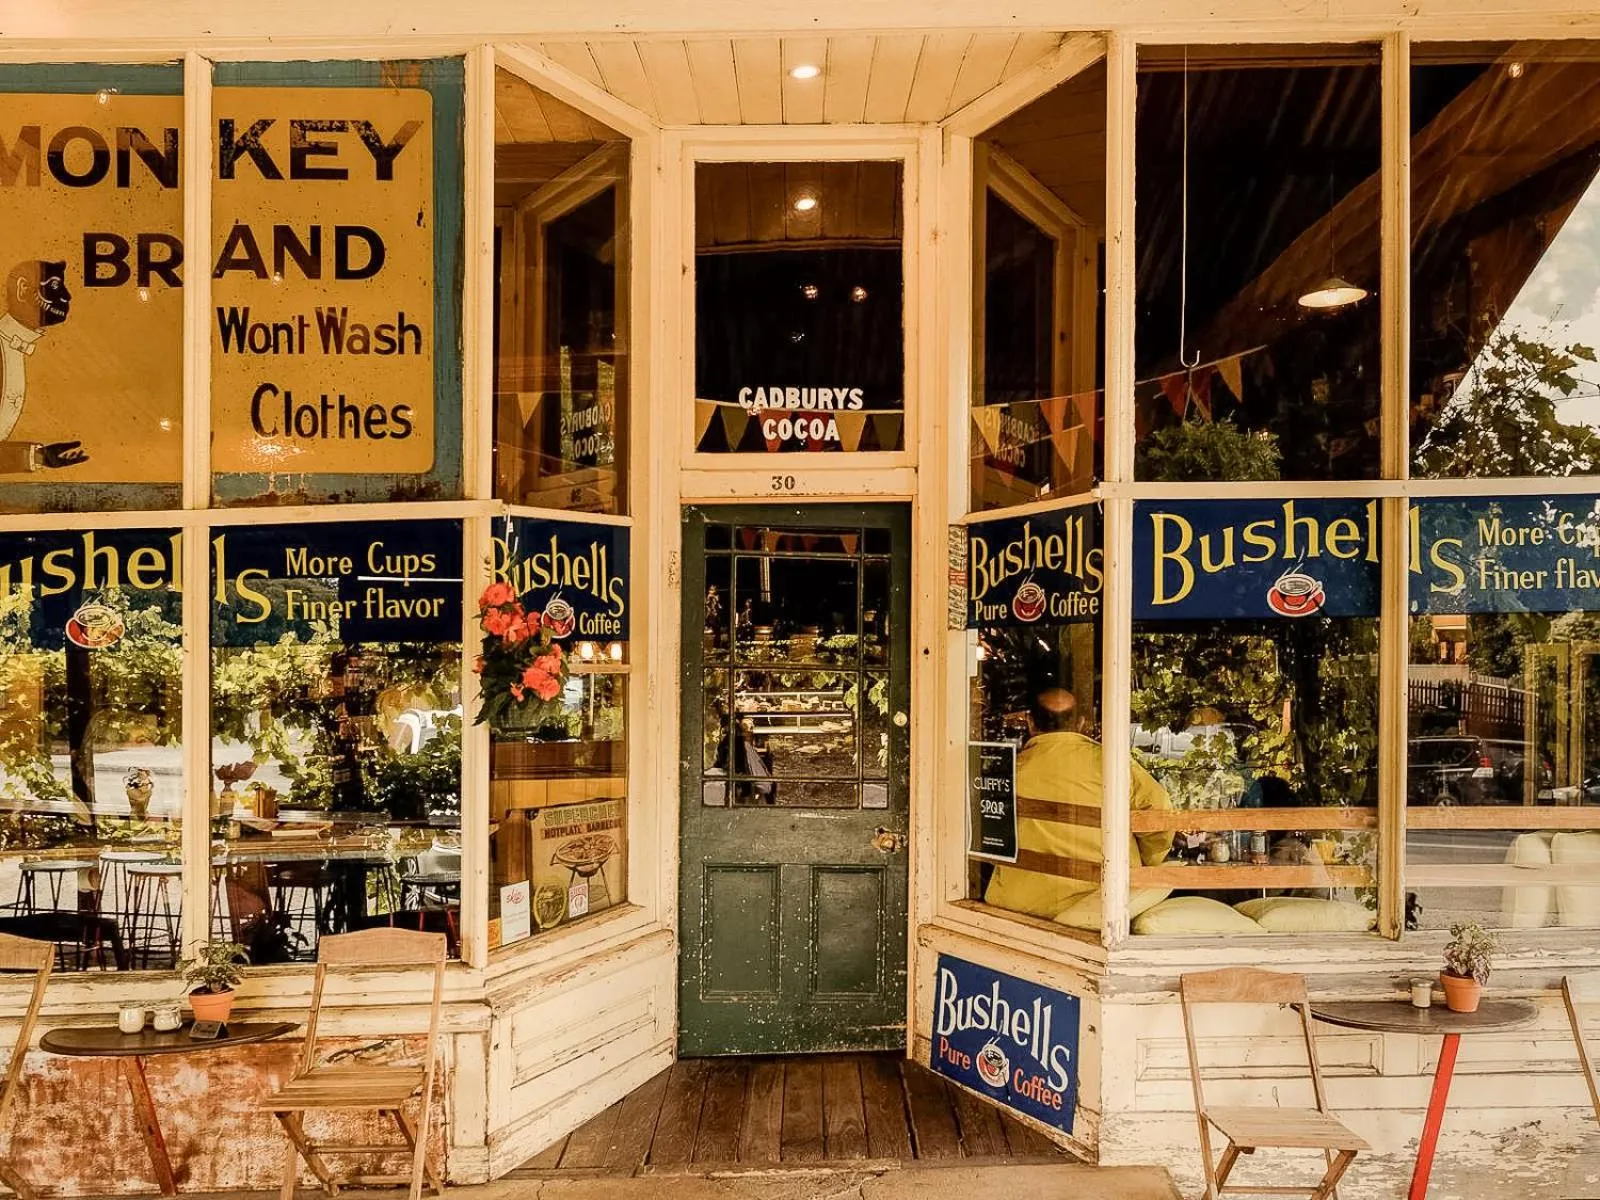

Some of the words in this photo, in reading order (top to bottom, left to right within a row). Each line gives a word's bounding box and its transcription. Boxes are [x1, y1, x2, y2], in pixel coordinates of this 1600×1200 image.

[83, 225, 385, 288] BRAND
[316, 307, 422, 355] Wash
[251, 383, 413, 440] Clothes
[738, 386, 863, 411] CADBURYS
[762, 418, 840, 441] COCOA
[771, 475, 795, 490] 30
[1150, 499, 1466, 605] Bushells
[1478, 519, 1545, 546] More
[0, 531, 271, 623] ushells
[285, 547, 353, 576] More
[367, 541, 436, 585] Cups
[490, 534, 625, 617] Bushells
[971, 515, 1104, 601] Bushells
[1479, 559, 1548, 590] Finer
[1554, 557, 1600, 589] flav
[285, 589, 357, 621] Finer
[364, 587, 445, 620] flavor
[579, 611, 621, 635] Coffee
[975, 600, 1008, 620] Pure
[1050, 591, 1099, 618] Coffee
[980, 799, 1005, 815] SPQR
[936, 967, 1070, 1093] Bushells
[939, 1036, 971, 1069] Pure
[1014, 1068, 1063, 1111] Coffee
